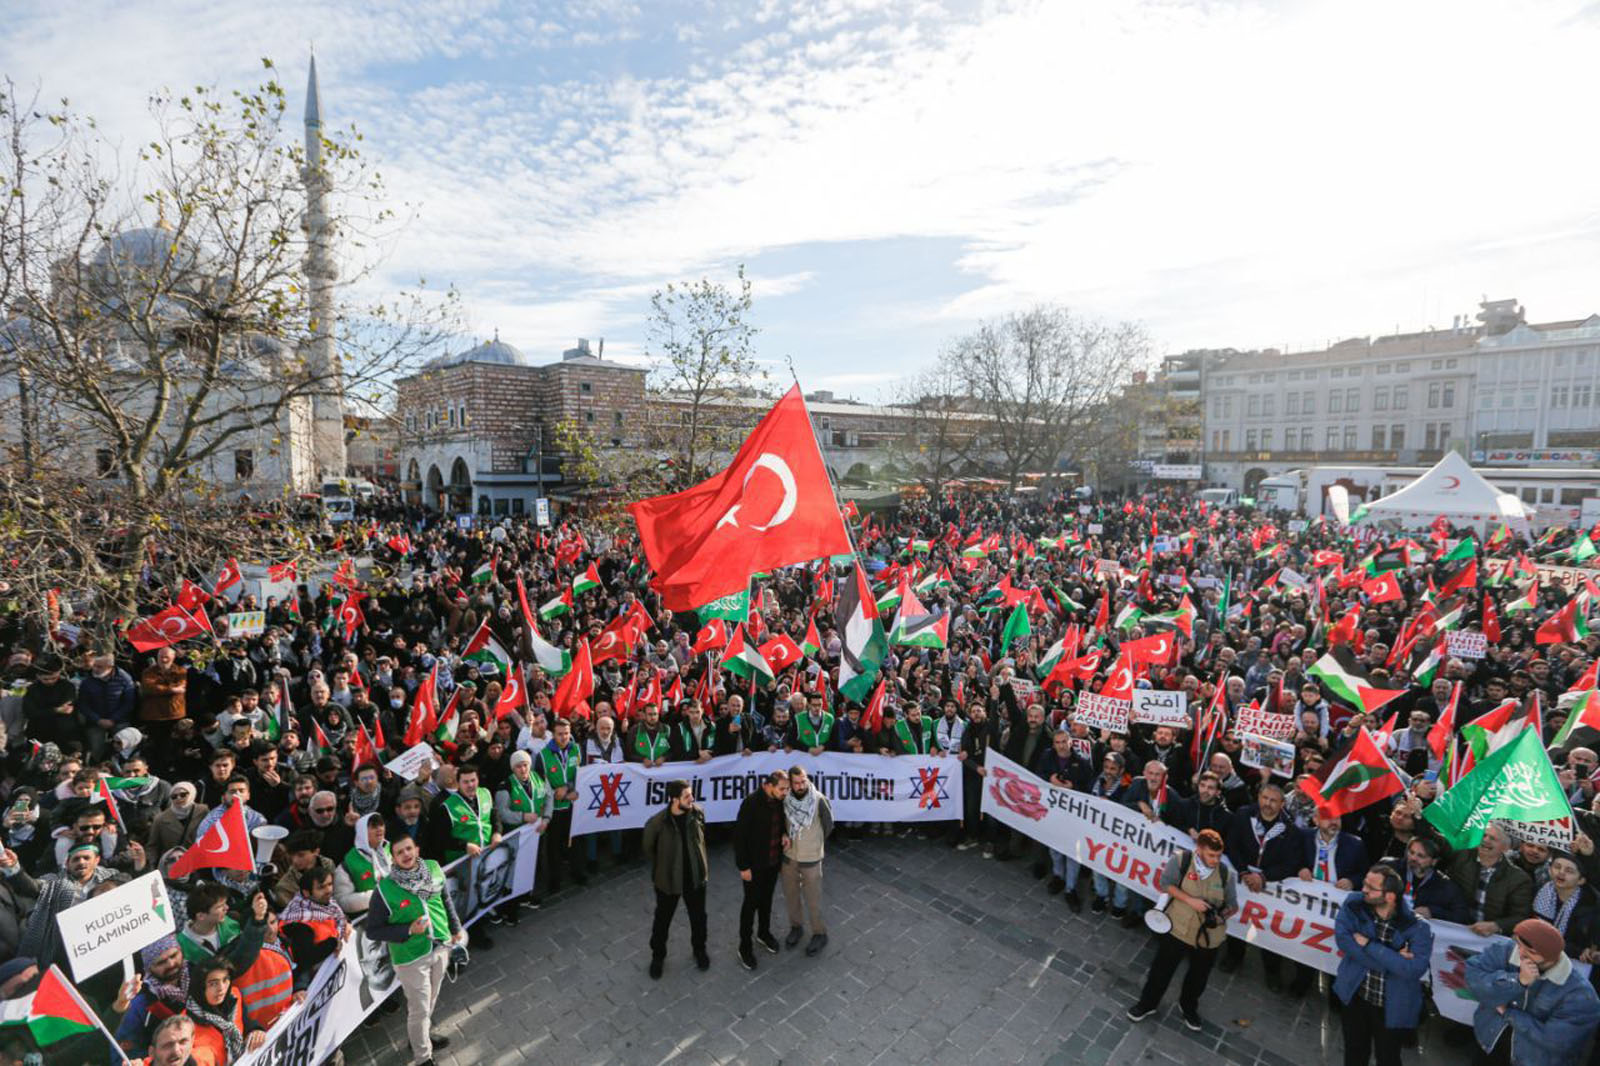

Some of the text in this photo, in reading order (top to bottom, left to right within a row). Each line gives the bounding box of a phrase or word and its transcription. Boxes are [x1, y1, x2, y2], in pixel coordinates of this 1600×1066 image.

[1080, 691, 1129, 708] REFAH
[1077, 708, 1127, 724] KAPISI
[1079, 700, 1128, 717] SINIR
[1240, 708, 1295, 722] REFAH
[1240, 717, 1293, 730] SINIR
[645, 775, 707, 806] İSİL
[808, 771, 895, 801] ÜTÜDÜR!
[1518, 821, 1570, 841] RAFAH
[85, 904, 132, 934] KUDUS
[73, 912, 151, 958] İSLAMINDIR
